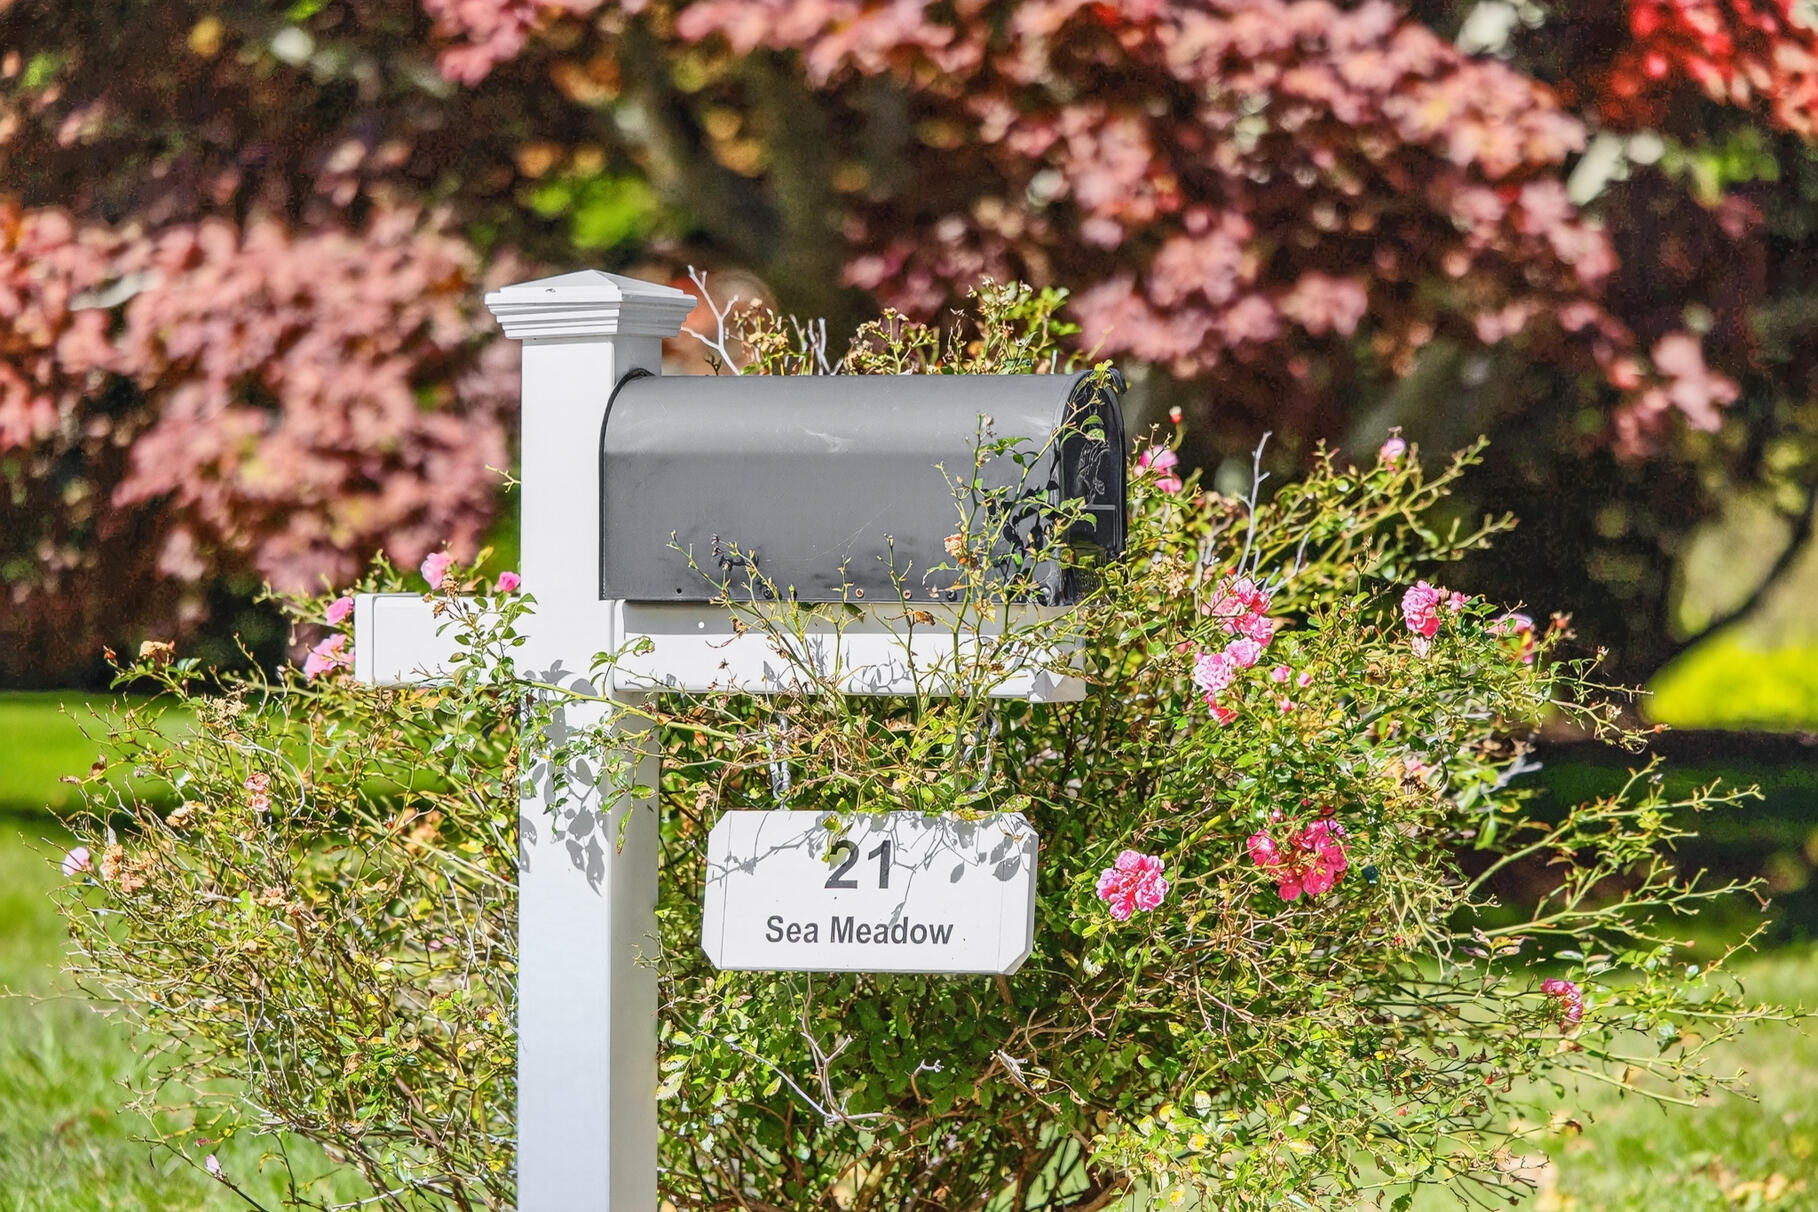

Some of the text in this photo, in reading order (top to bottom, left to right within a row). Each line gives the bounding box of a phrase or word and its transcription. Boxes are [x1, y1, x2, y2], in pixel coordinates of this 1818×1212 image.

[824, 839, 891, 889] 21
[766, 915, 954, 945] Sea Meadow
